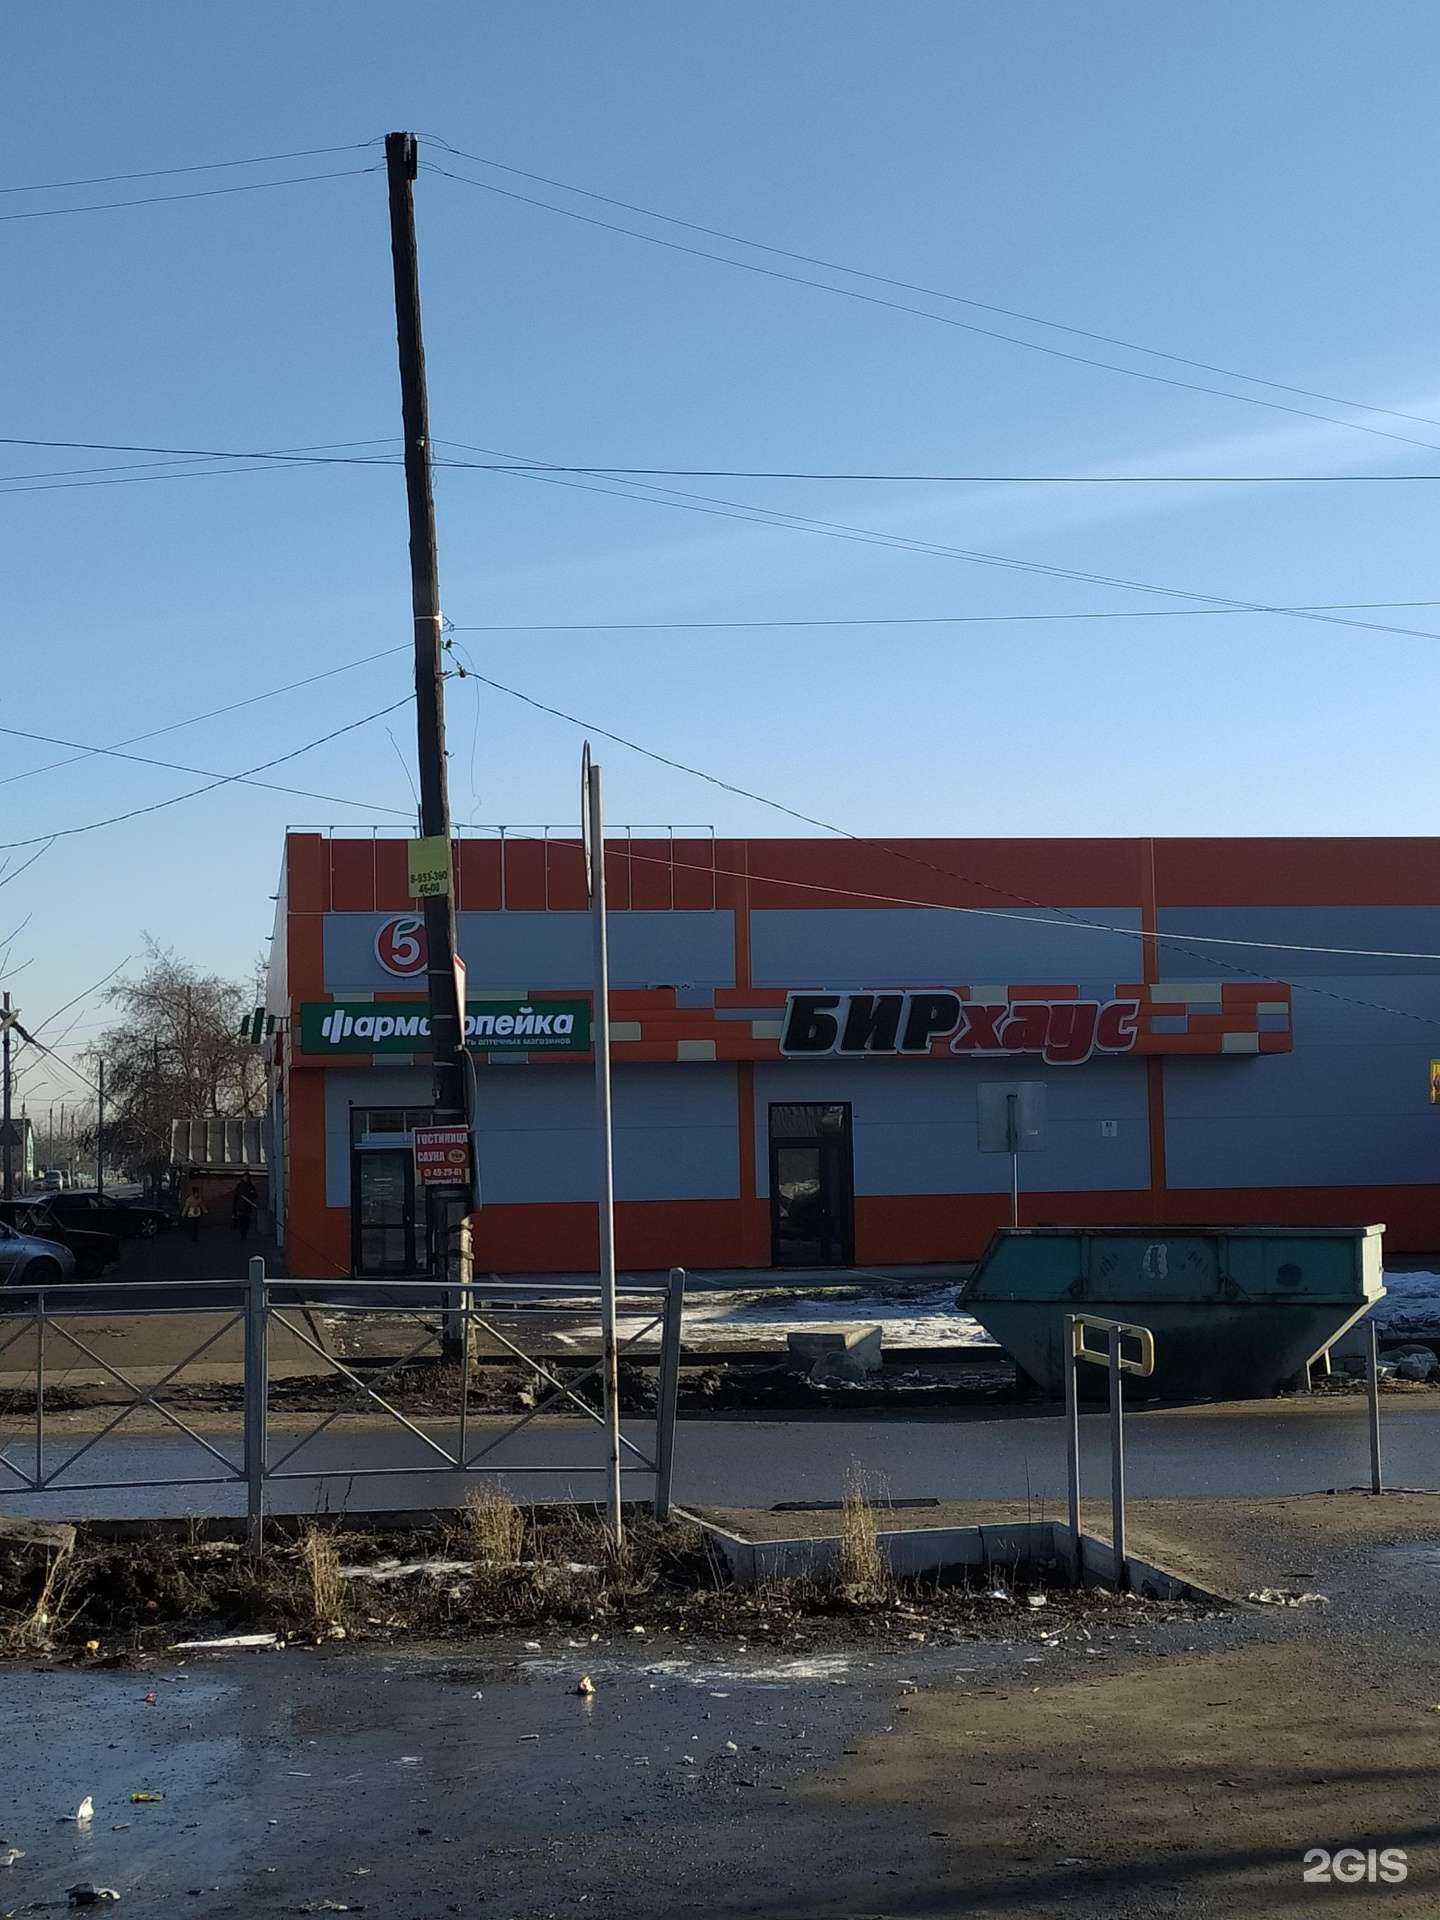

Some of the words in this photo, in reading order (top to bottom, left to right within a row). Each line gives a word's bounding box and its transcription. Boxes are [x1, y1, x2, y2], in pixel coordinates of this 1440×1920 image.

[391, 919, 421, 966] 5
[321, 1007, 574, 1044] фармаопейка
[780, 990, 1141, 1065] БИРхаус
[416, 1132, 468, 1145] ГОСТИНИЦА
[417, 1151, 446, 1163] САУНА
